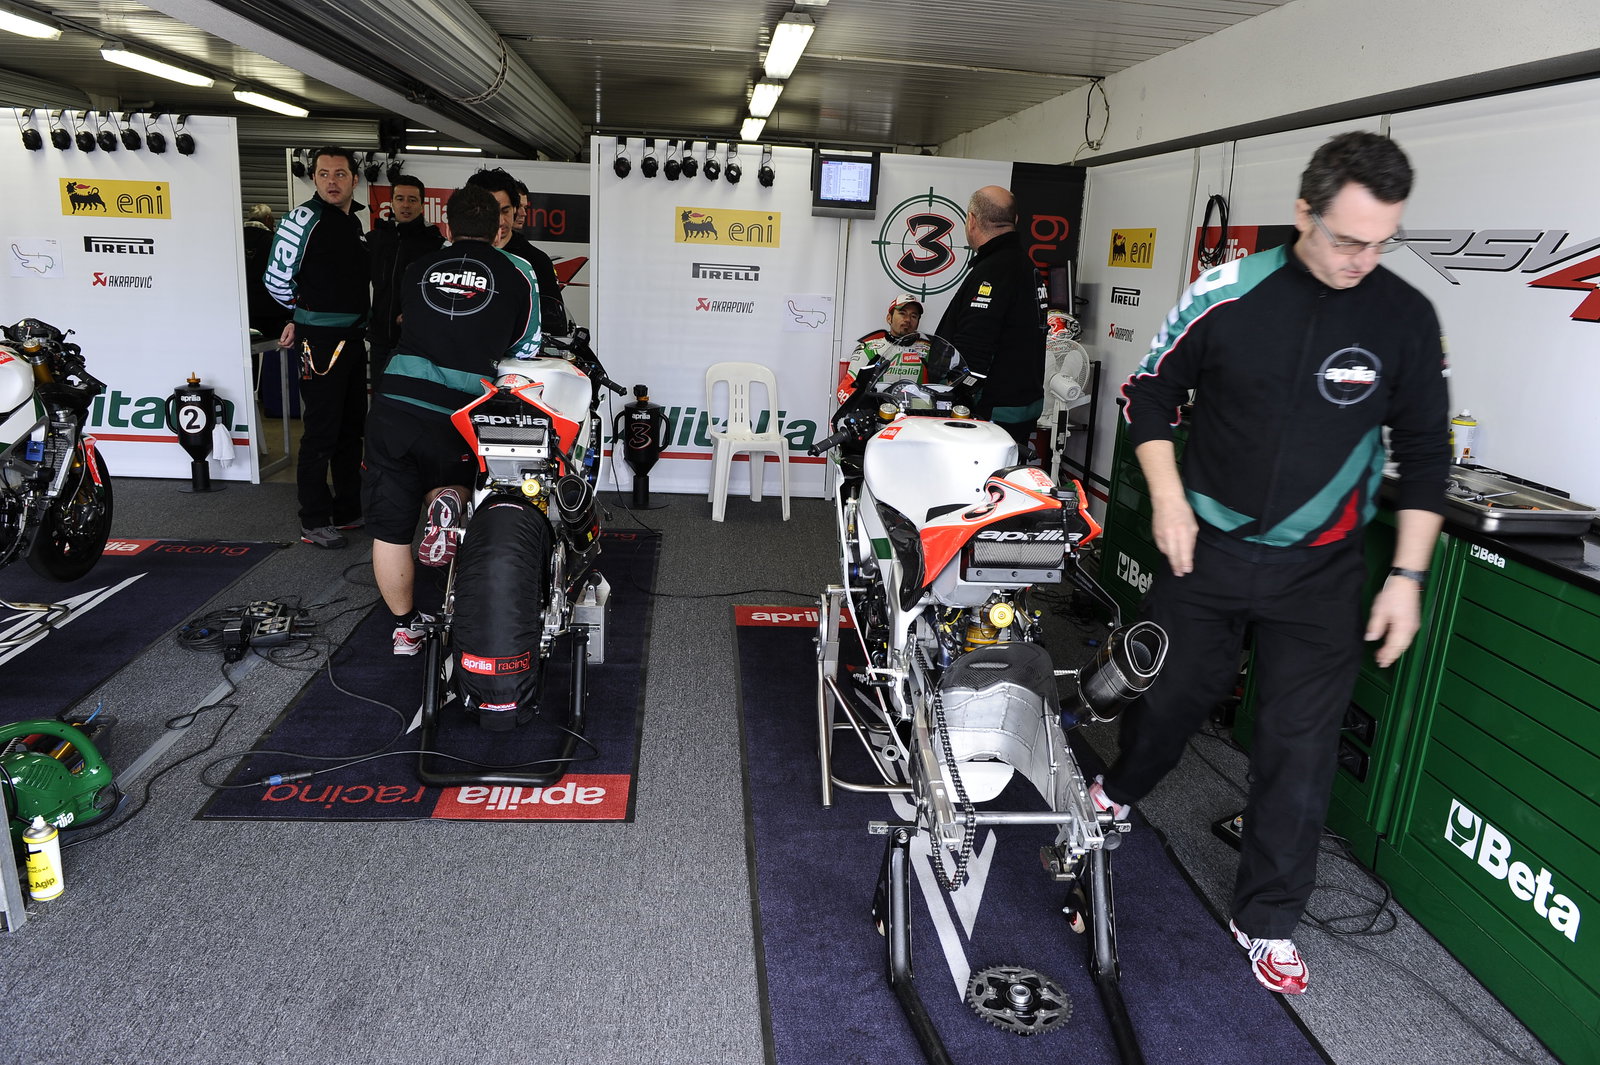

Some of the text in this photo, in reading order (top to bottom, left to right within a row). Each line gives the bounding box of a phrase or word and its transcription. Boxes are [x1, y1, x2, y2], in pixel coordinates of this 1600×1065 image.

[116, 185, 164, 215] eni
[727, 215, 773, 244] eni
[84, 236, 154, 255] PIRELLI
[896, 212, 956, 277] 3
[1130, 233, 1153, 264] eni
[429, 271, 488, 291] aprilia
[692, 262, 760, 281] PIRELLI
[1111, 287, 1141, 307] PIRELLI
[180, 394, 202, 402] aprilia
[183, 409, 201, 430] 2
[631, 411, 651, 421] aprilia
[628, 422, 653, 450] 3
[977, 529, 1083, 542] aprilia
[154, 544, 251, 557] racing
[1480, 547, 1506, 569] Beta
[1127, 558, 1154, 595] Bet
[463, 657, 529, 671] aprilia racing
[262, 781, 606, 811] aprilia racing
[35, 877, 55, 889] Agip
[1477, 828, 1581, 943] Beta
